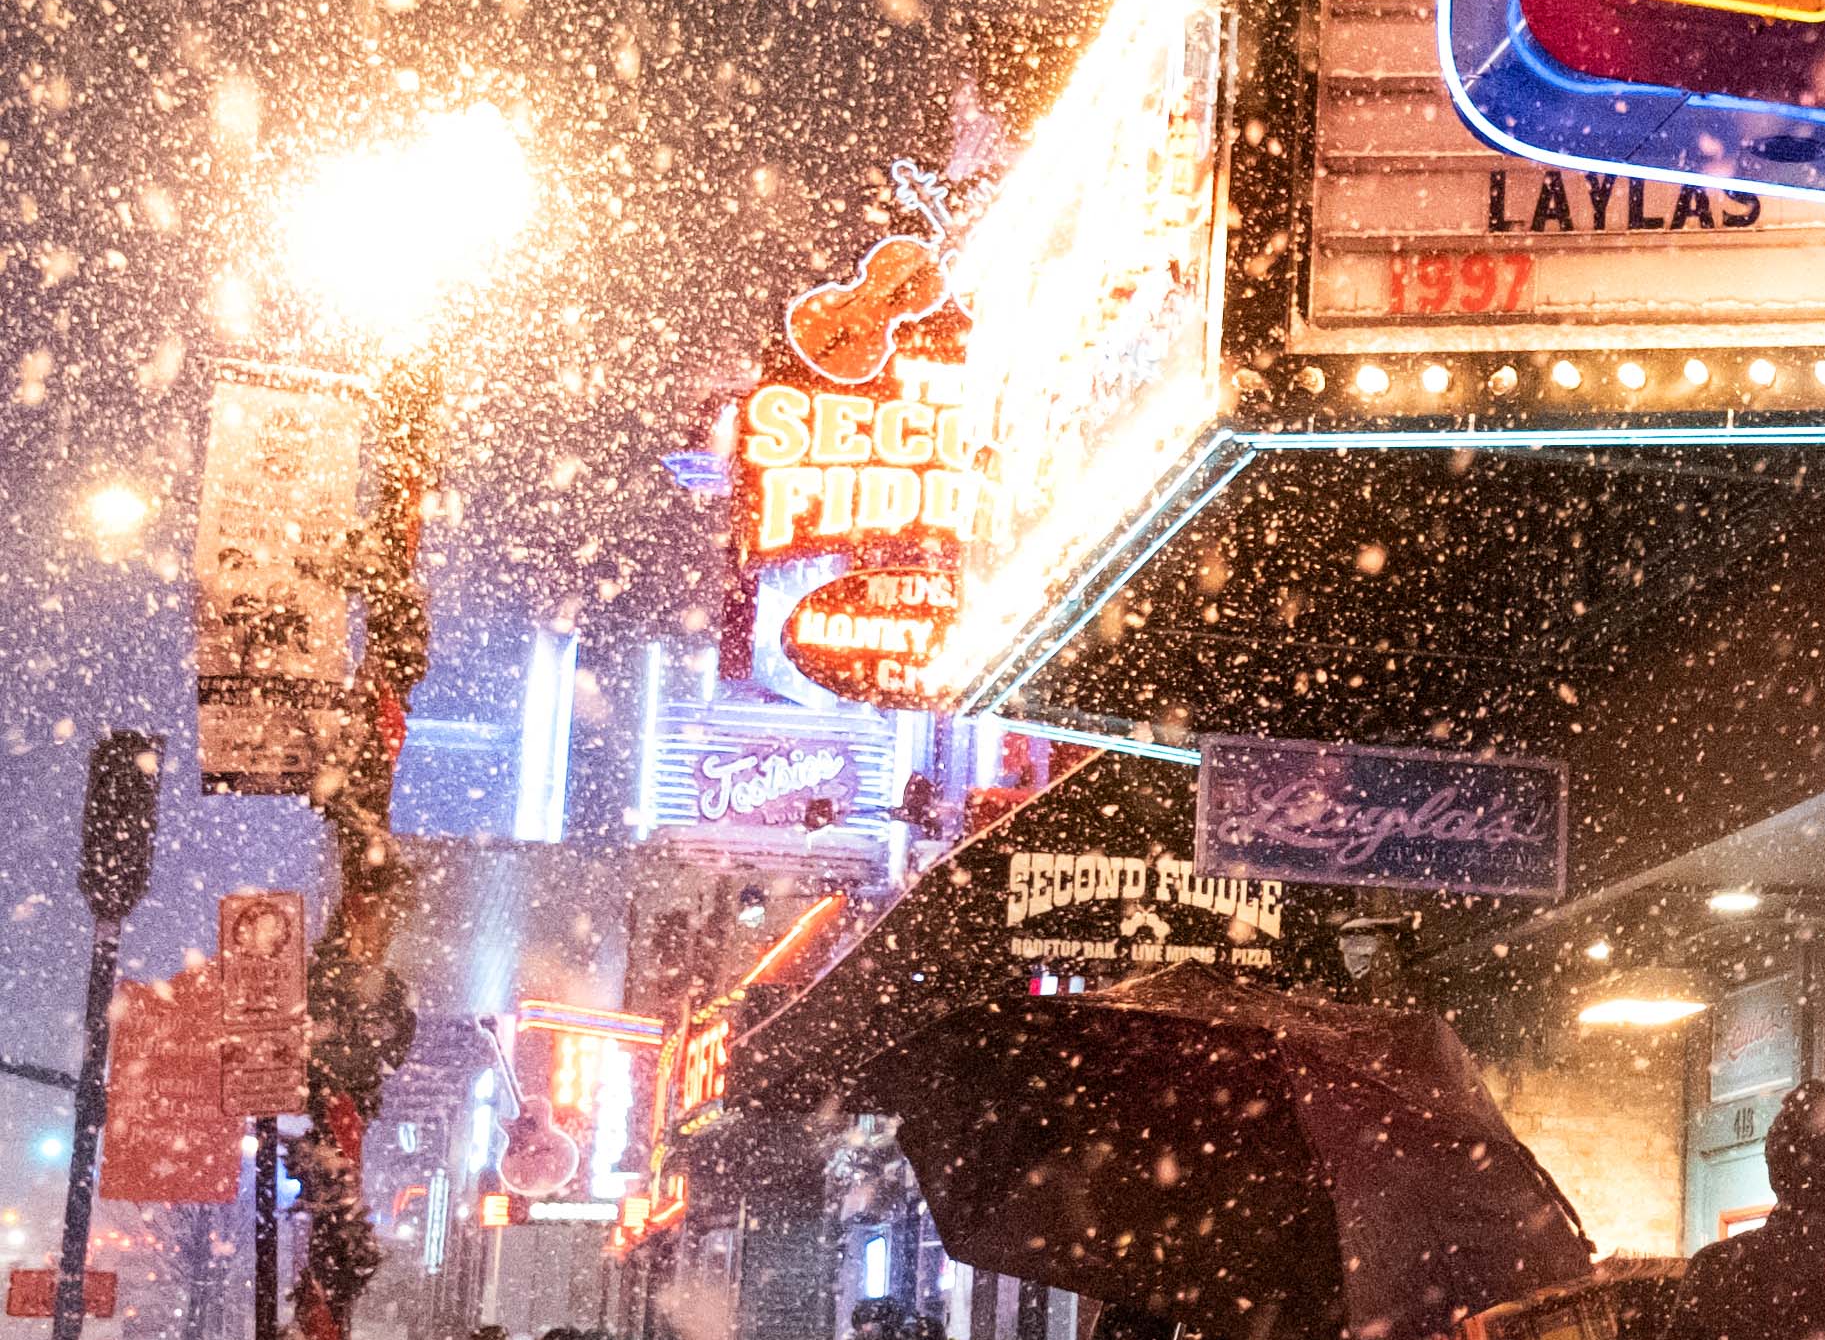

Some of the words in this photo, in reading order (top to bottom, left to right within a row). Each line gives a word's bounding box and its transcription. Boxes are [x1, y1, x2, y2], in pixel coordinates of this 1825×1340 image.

[1488, 168, 1762, 234] LAYLAS
[1389, 252, 1535, 315] 1997
[1005, 851, 1148, 928] SECOND
[1010, 938, 1083, 961] ROOFTOP
[1130, 943, 1164, 962] LIVE
